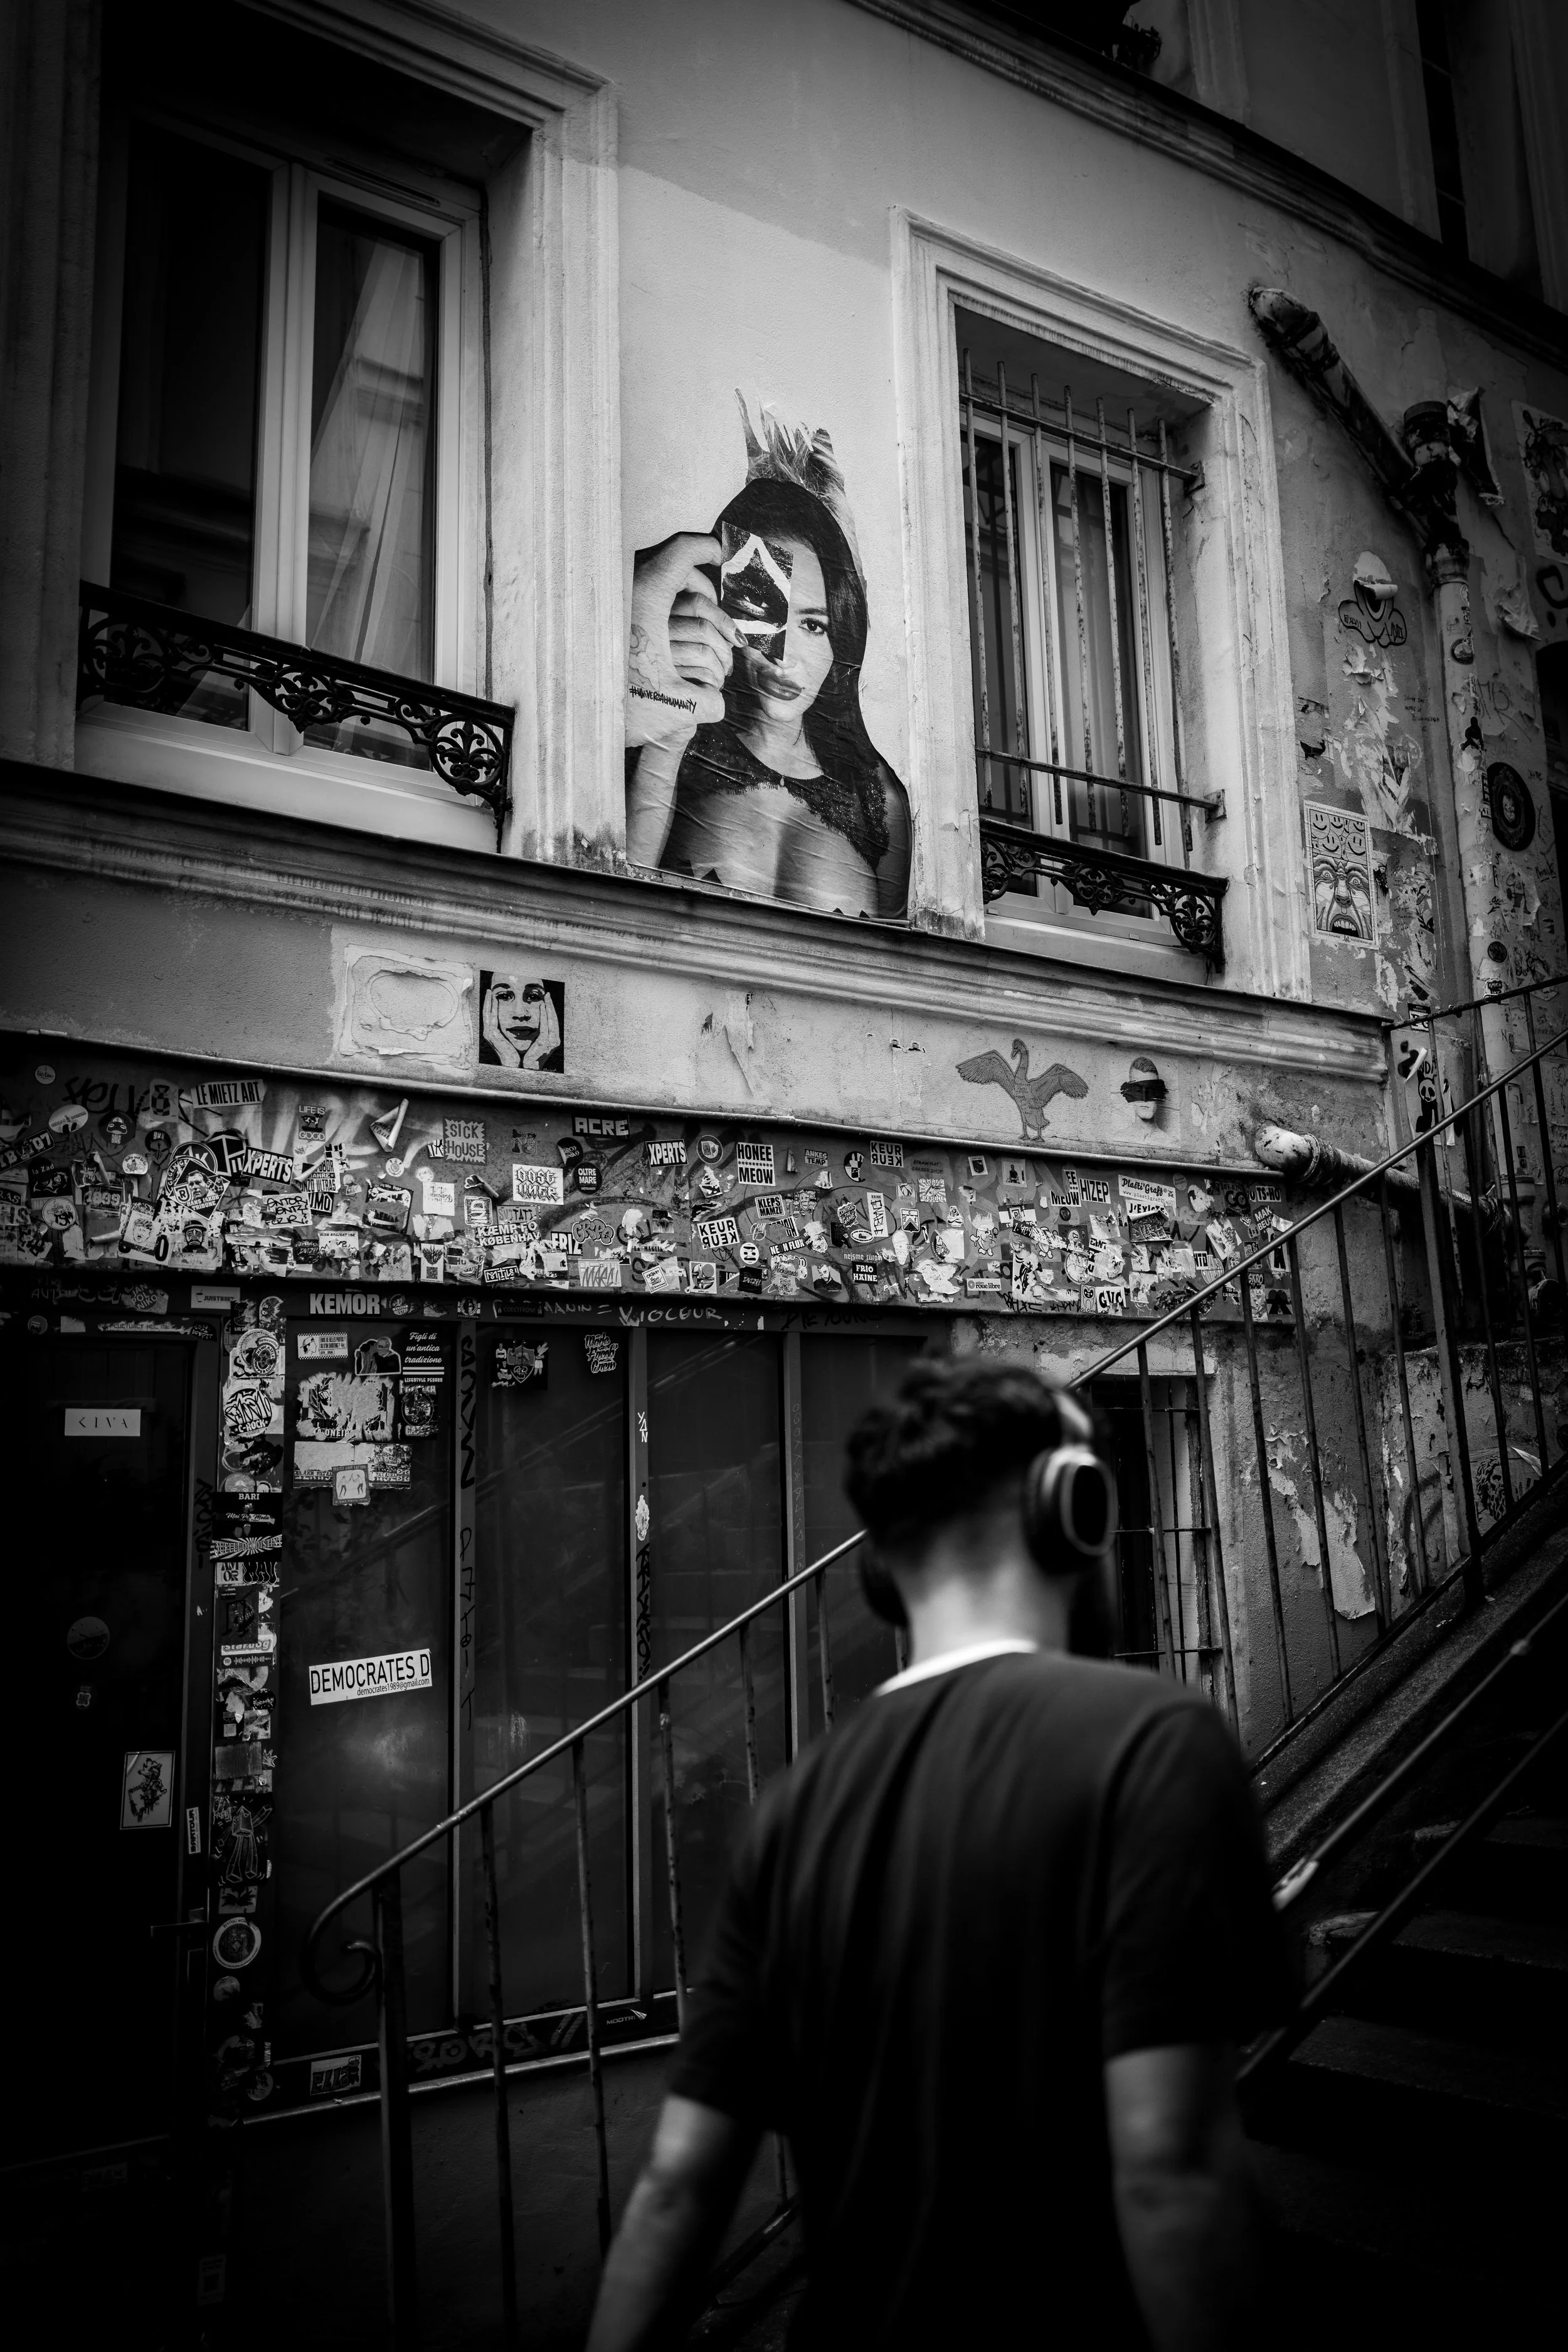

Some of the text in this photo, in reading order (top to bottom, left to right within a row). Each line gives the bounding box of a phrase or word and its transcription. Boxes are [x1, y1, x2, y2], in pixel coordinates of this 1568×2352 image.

[196, 1082, 260, 1105] LE MIETZ ART
[299, 1105, 316, 1113] LIFE
[450, 1123, 479, 1138] SICK
[575, 1117, 629, 1136] ACRE
[299, 1131, 325, 1140] GOOD
[447, 1141, 484, 1158] HOUSE
[648, 1142, 686, 1165] XPERTS
[738, 1143, 772, 1162] HONEE
[805, 1150, 827, 1158] ANKES
[871, 1142, 901, 1156] KEUR
[41, 1164, 55, 1172] Zad
[242, 1149, 292, 1182] XPERTS
[807, 1157, 825, 1165] TEMP
[578, 1168, 596, 1176] OLTRE
[739, 1167, 773, 1184] MEOW
[317, 1180, 336, 1192] ULTRAS
[1079, 1179, 1108, 1202] HIZEP
[187, 1194, 220, 1207] HANS JAKOB
[191, 1201, 216, 1211] TRIBÜNE
[758, 1197, 781, 1208] KLEPS
[760, 1206, 783, 1217] MAMZL
[1255, 1206, 1272, 1221] MAK
[842, 1216, 856, 1225] GAME
[478, 1220, 538, 1237] KÆMP FO
[699, 1220, 735, 1236] KEUR
[480, 1232, 541, 1246] KØBENHAV
[770, 1238, 805, 1255] NEON FLUX
[132, 1283, 148, 1297] JAN
[131, 1293, 149, 1305] POL
[136, 1294, 157, 1310] NIKO
[310, 1293, 380, 1315] KEMOR
[409, 1332, 437, 1342] Figli di
[405, 1355, 442, 1364] tradizione
[311, 1654, 430, 1694] DEMOCRATES D
[357, 1677, 430, 1697] democrates1989@gmail.com
